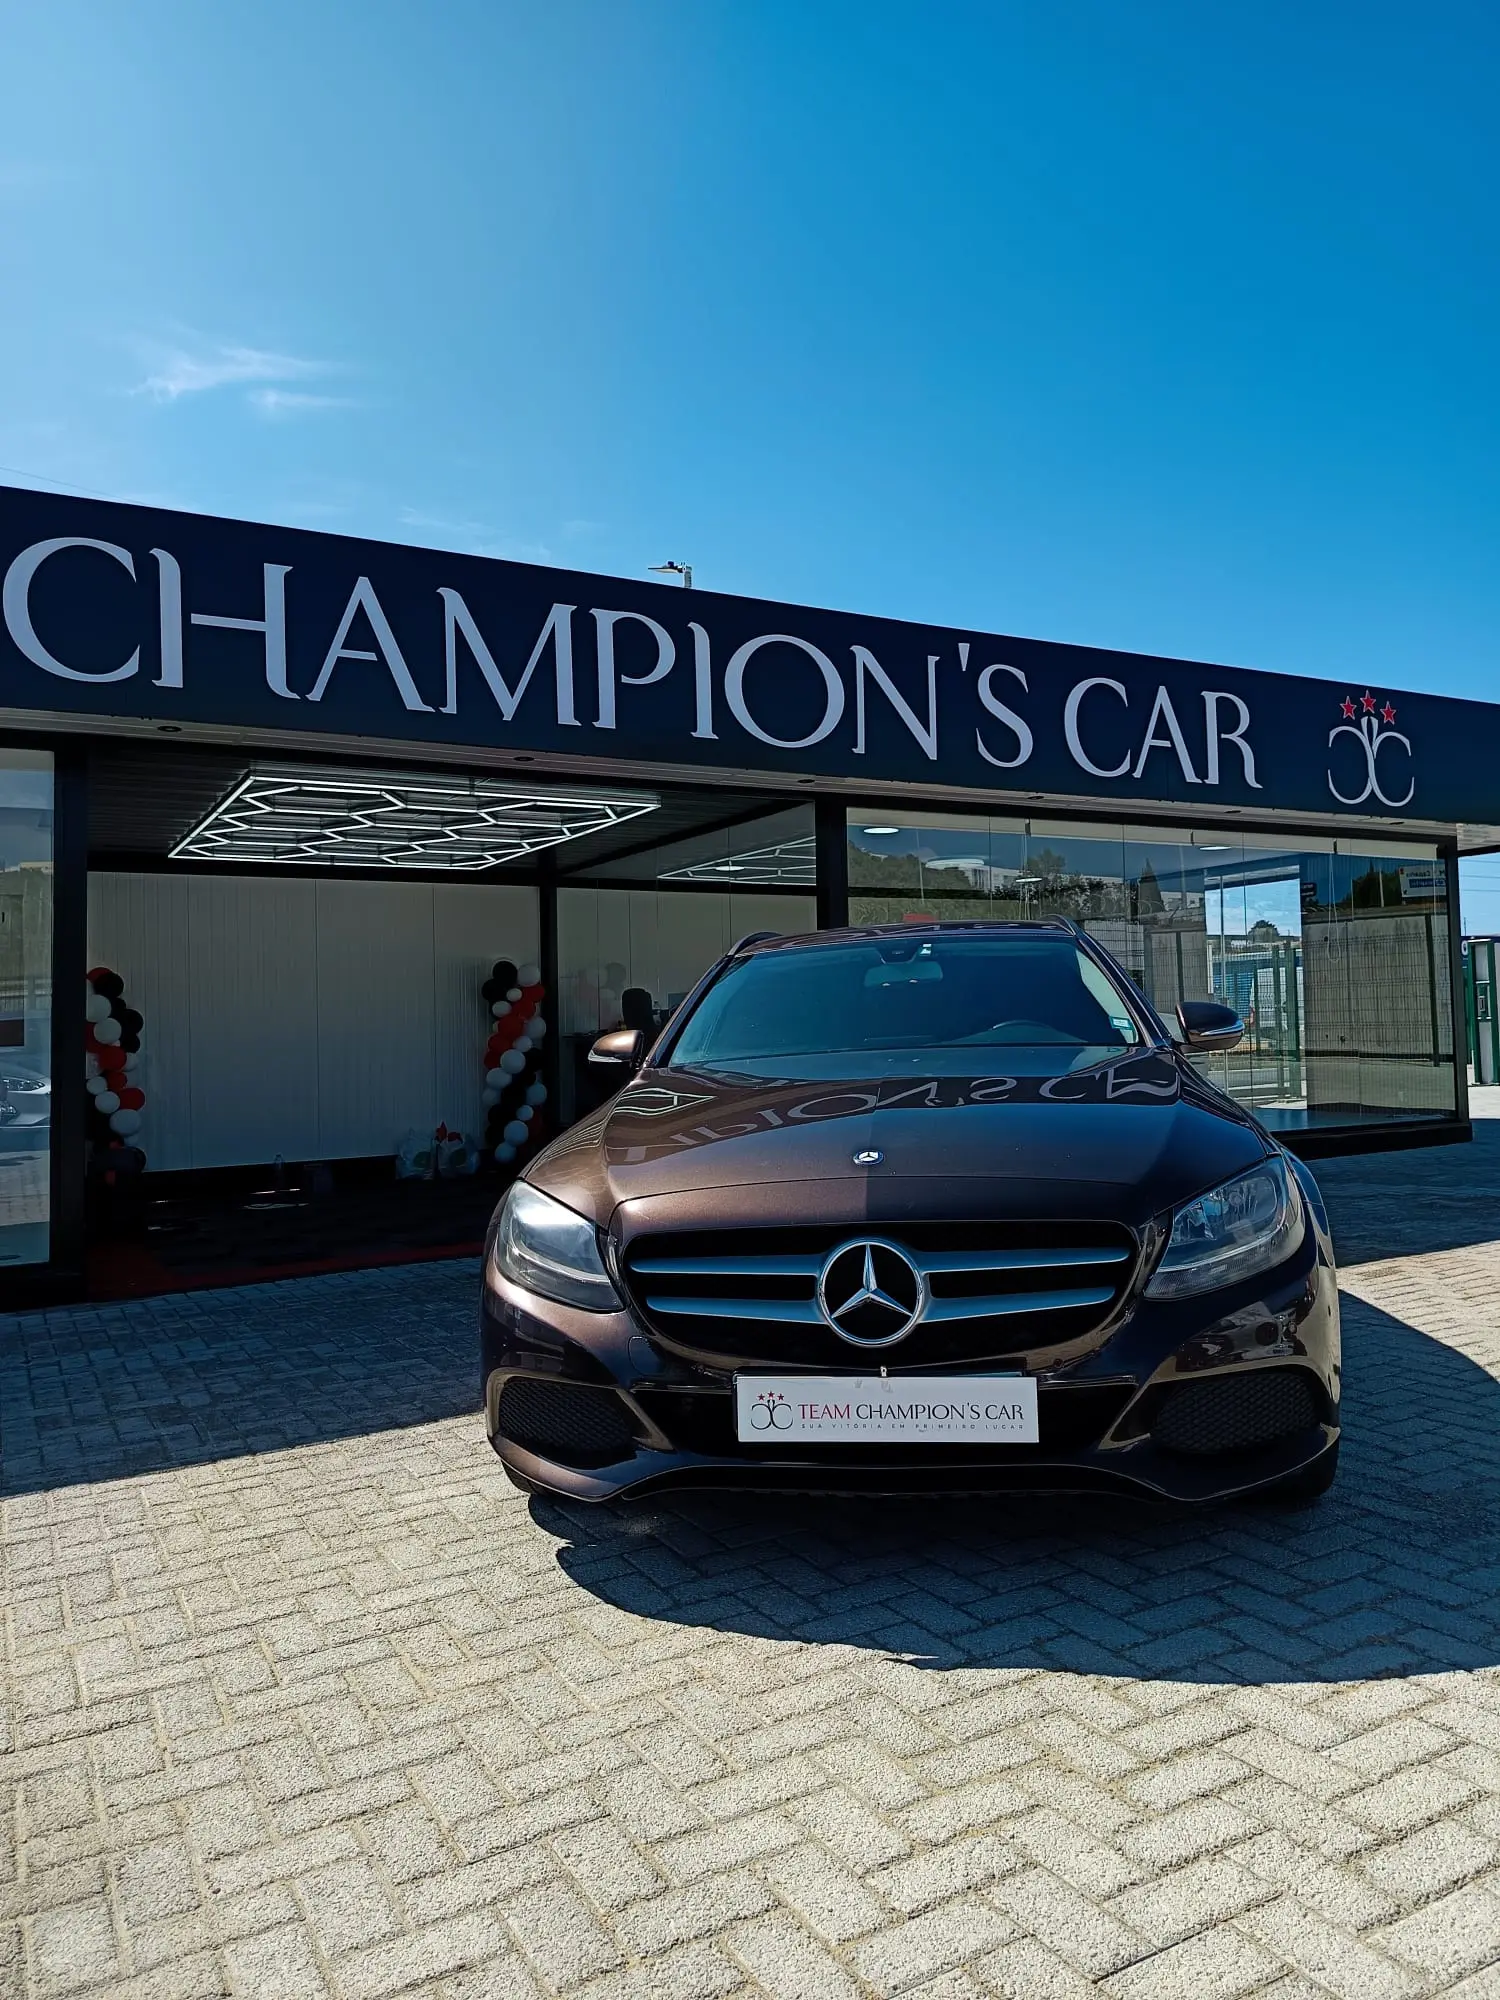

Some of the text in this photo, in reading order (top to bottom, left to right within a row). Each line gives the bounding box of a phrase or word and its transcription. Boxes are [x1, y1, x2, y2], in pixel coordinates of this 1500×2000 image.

[2, 536, 1263, 789] CHAMPION'S CAR
[797, 1401, 1025, 1421] TEAM CHAMPION'S CAR
